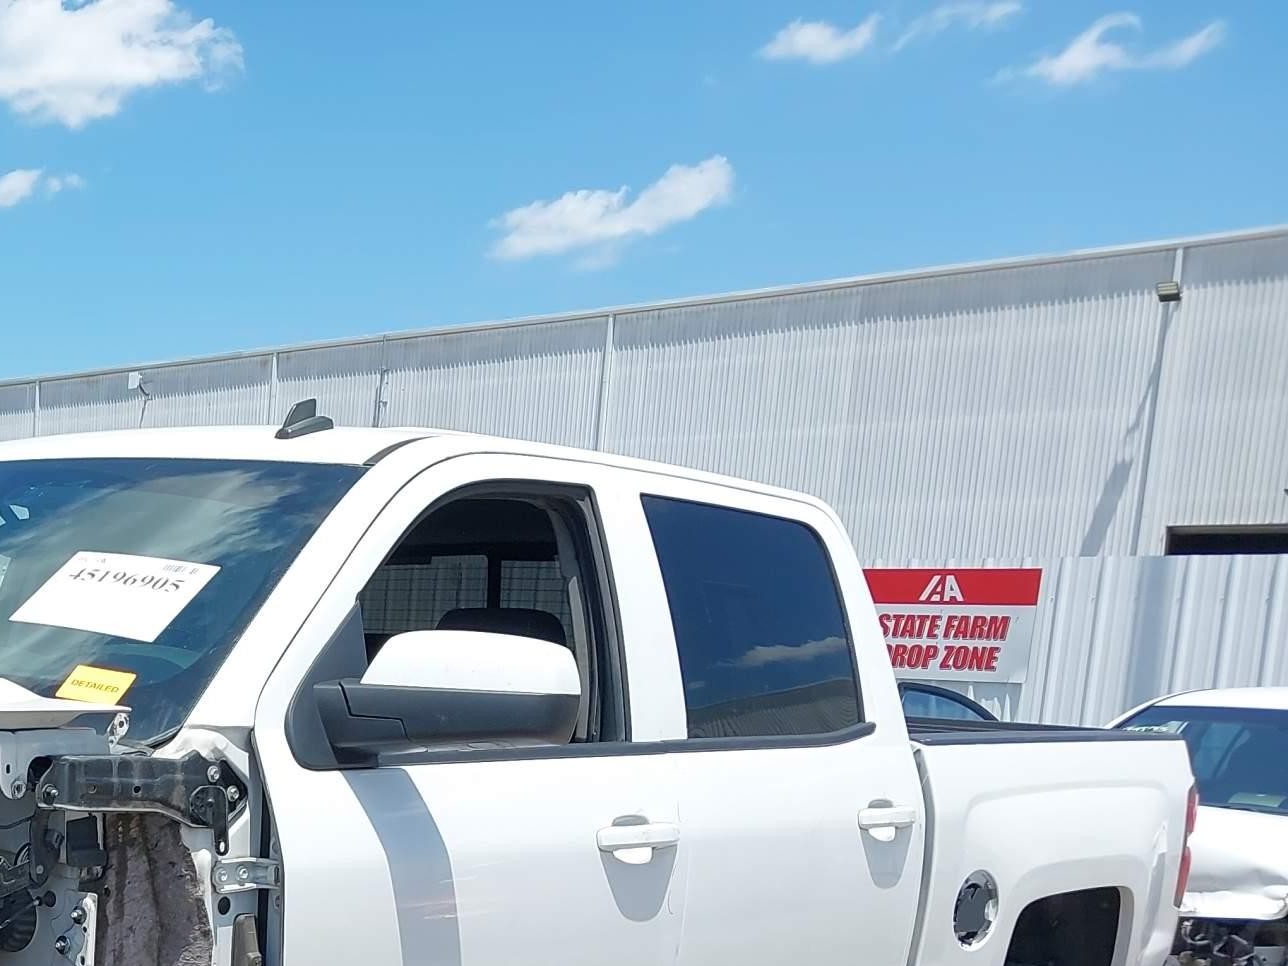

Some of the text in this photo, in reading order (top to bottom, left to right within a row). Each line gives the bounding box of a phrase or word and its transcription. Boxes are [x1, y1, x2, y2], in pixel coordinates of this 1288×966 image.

[69, 567, 185, 593] 45196905
[878, 613, 1011, 642] STATE FARM
[886, 643, 1001, 672] ROP ZONE
[70, 678, 120, 694] DETAILED
